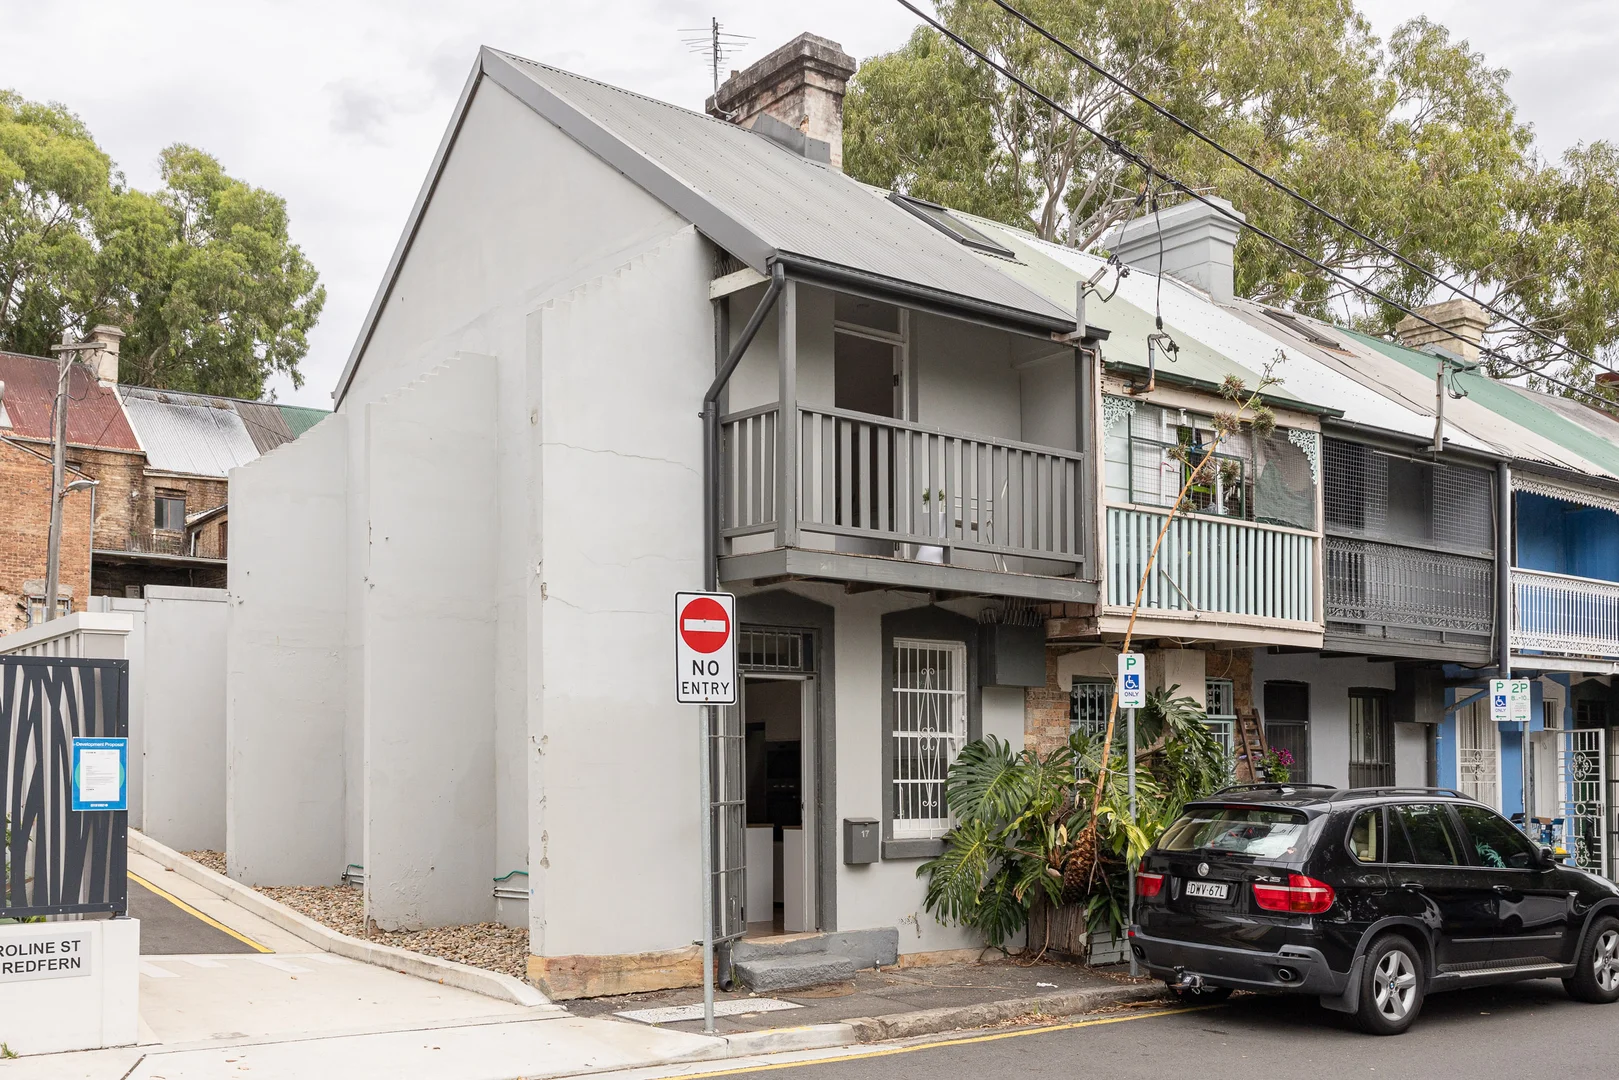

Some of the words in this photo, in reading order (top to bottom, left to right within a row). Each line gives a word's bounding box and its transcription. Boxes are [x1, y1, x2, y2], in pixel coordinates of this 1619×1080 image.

[693, 660, 719, 676] NO
[1127, 658, 1136, 670] P
[682, 682, 729, 695] ENTRY
[1496, 682, 1504, 692] P
[1512, 683, 1528, 693] 2P
[861, 830, 870, 838] 17
[61, 940, 81, 953] ST
[2, 957, 81, 974] REDFERN
